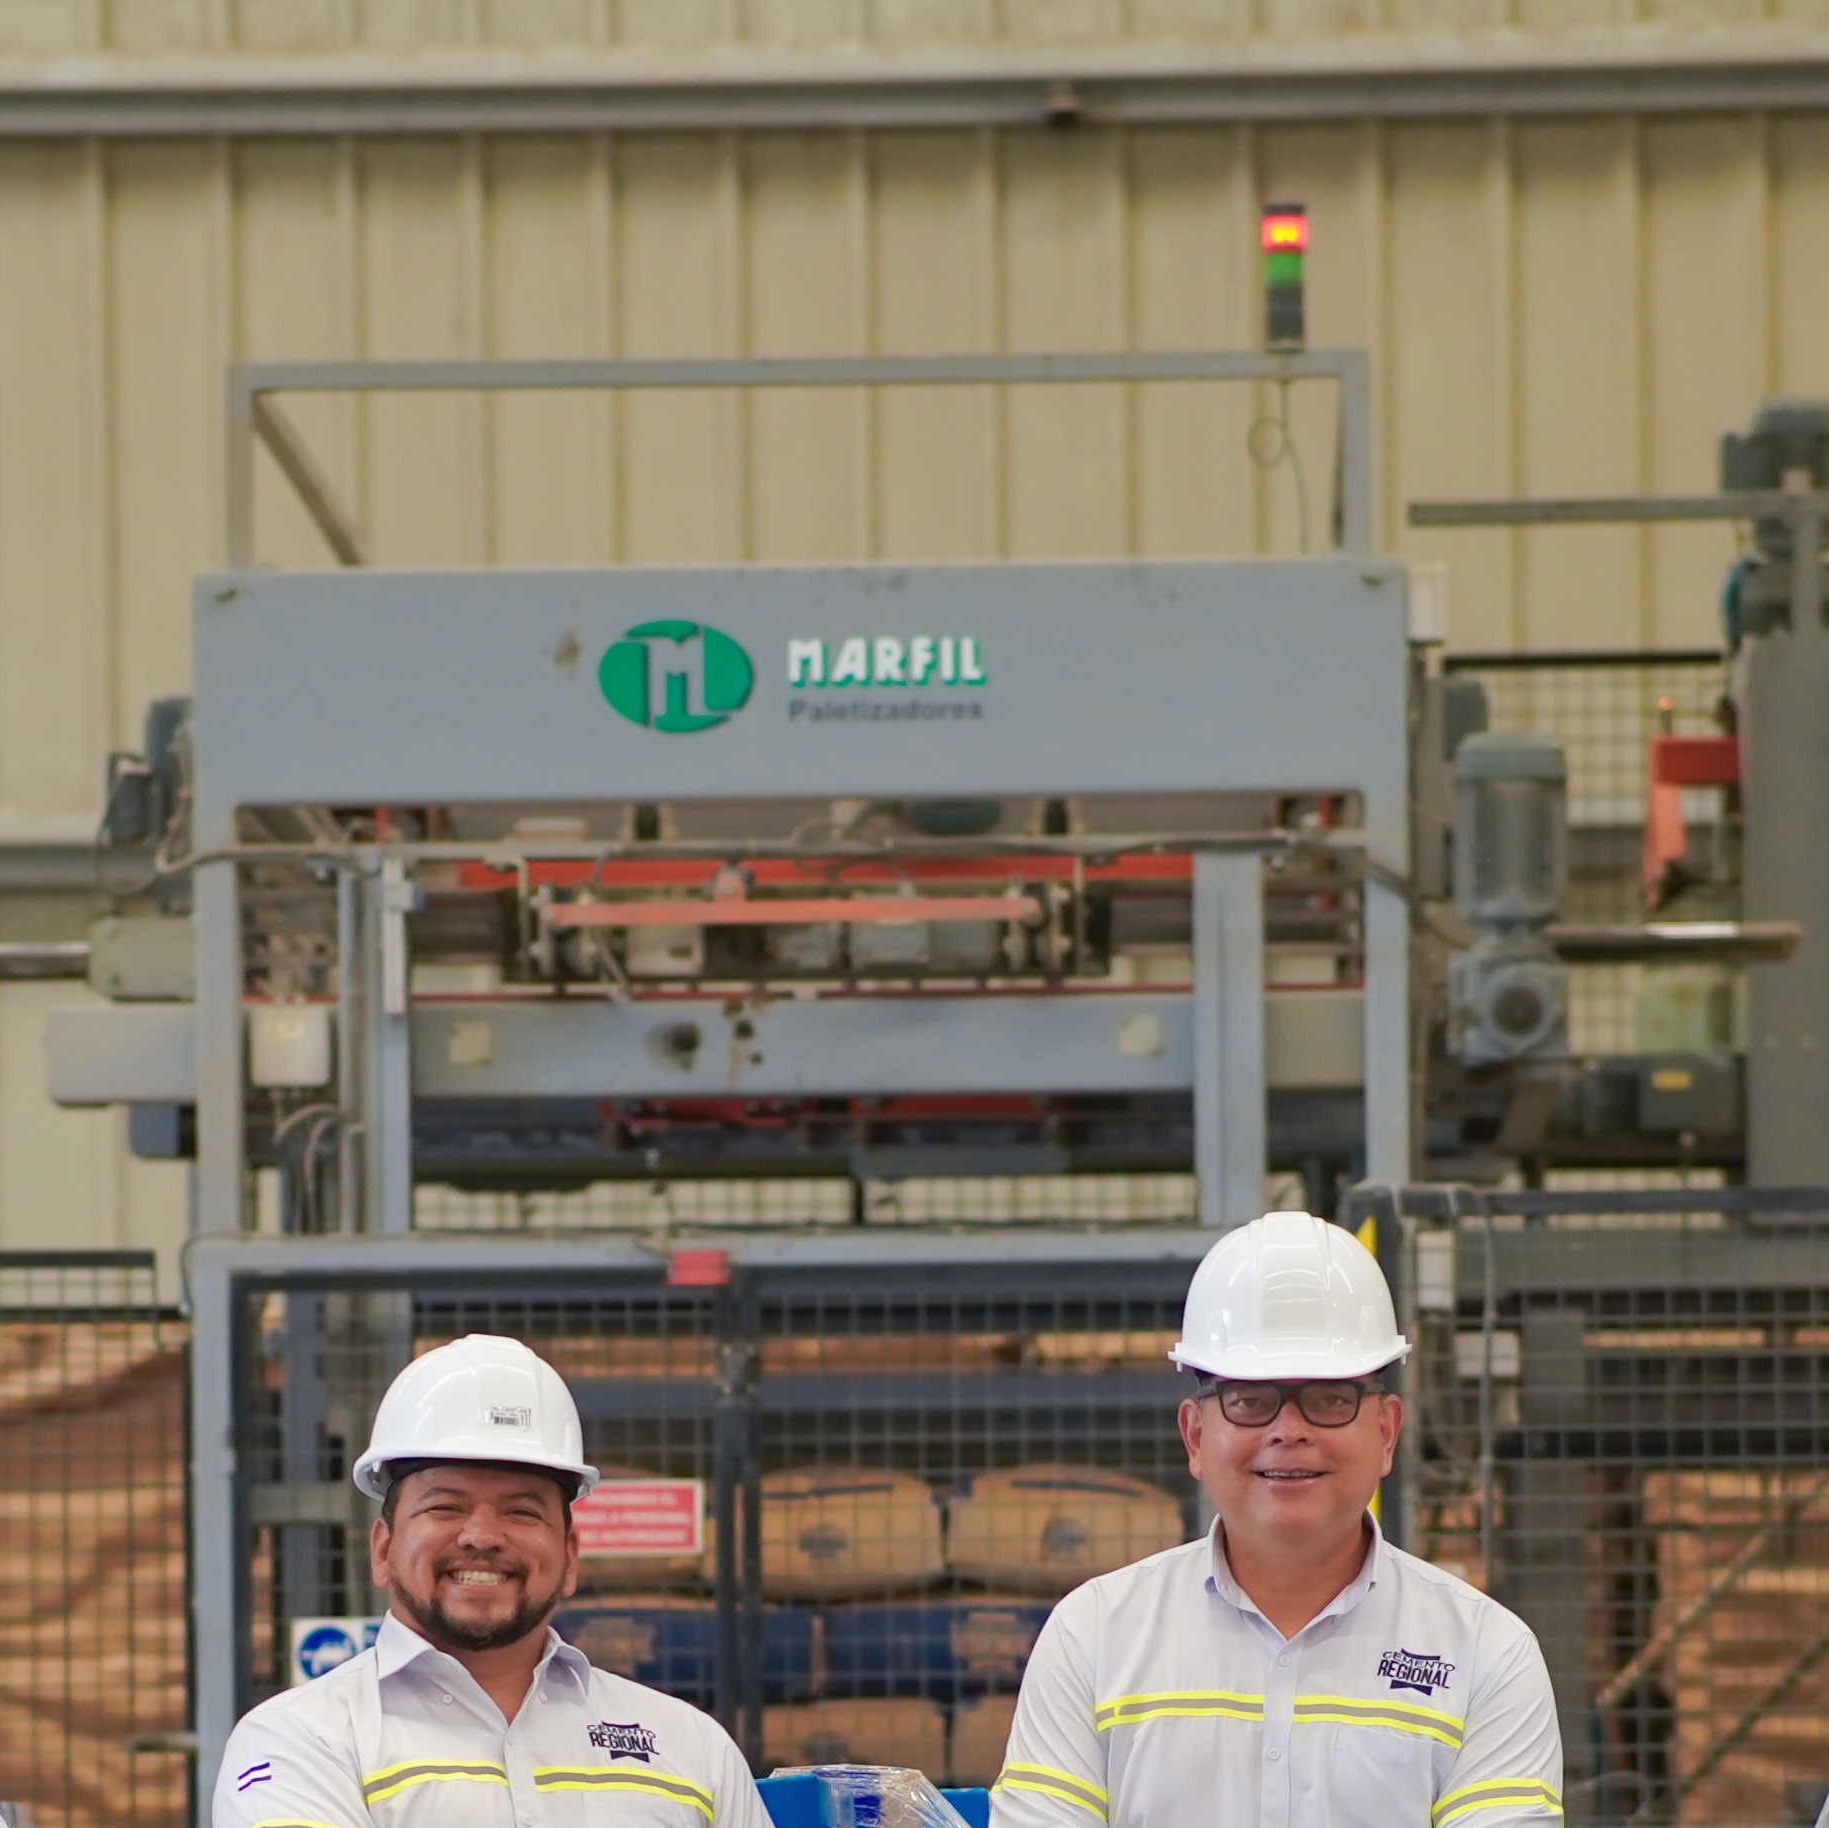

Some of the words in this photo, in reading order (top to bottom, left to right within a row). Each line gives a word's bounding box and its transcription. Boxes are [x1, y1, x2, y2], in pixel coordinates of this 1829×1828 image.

[786, 637, 987, 686] MARFIL
[787, 699, 984, 724] Paletizadores
[1382, 1651, 1456, 1671] CEMENTO
[1376, 1659, 1451, 1690] REGIONAL
[588, 1731, 661, 1756] REGIONAL
